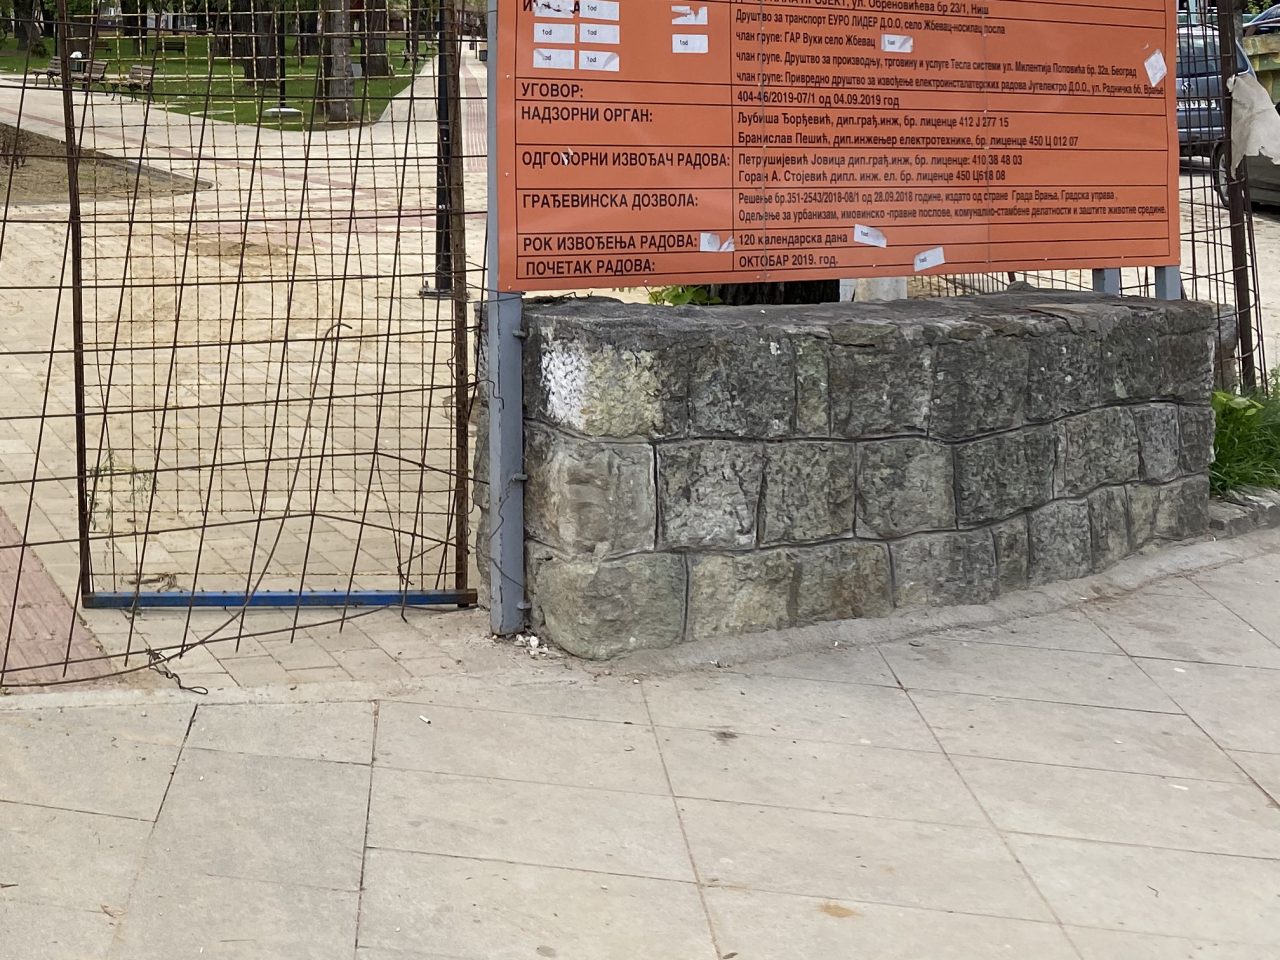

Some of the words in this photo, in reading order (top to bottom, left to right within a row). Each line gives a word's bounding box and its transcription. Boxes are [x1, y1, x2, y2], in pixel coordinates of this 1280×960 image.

[736, 9, 772, 24] Друштво
[785, 14, 826, 28] транспорт
[828, 14, 850, 27] ЕУРО
[851, 16, 878, 30] ЛИДЕР
[905, 22, 922, 31] село
[736, 31, 755, 40] члан
[784, 31, 801, 42] ГАР
[802, 32, 823, 45] Вуки
[824, 36, 844, 45] село
[845, 35, 876, 49] Жбевац
[521, 83, 583, 98] УГОВОР:
[818, 96, 832, 107] од
[884, 97, 899, 108] год
[521, 106, 599, 124] НАДЗОРНИ
[604, 108, 653, 123] ОРГАН:
[737, 112, 779, 126] Љубиша
[920, 118, 957, 129] лиценце
[959, 117, 974, 127] 412
[738, 132, 792, 146] Бранислав
[990, 138, 1027, 148] лиценце
[1029, 136, 1044, 146] 450
[1053, 136, 1068, 147] 012
[522, 151, 608, 169] ОДГОВОРНИ
[612, 152, 673, 167] ИЗВОЂАЧ
[677, 153, 730, 169] РАДОВА:
[811, 155, 846, 168] Јовица
[972, 155, 987, 165] 410
[738, 171, 769, 184] Горан
[783, 170, 828, 183] Стојевић
[916, 173, 953, 183] лиценце
[955, 171, 970, 181] 450
[523, 194, 628, 209] ГРАЂЕВИНСКА
[632, 193, 698, 210] ДОЗВОЛА:
[523, 237, 553, 251] РОК
[557, 235, 636, 250] ИЗВОЂЕЊА
[640, 234, 698, 251] РАДОВА:
[739, 234, 755, 245] 120
[758, 234, 822, 246] календарска
[825, 234, 848, 245] дана
[526, 260, 592, 276] ПОЧЕТАК
[596, 259, 655, 275] РАДОВА:
[739, 255, 789, 267] ОКТОБАР
